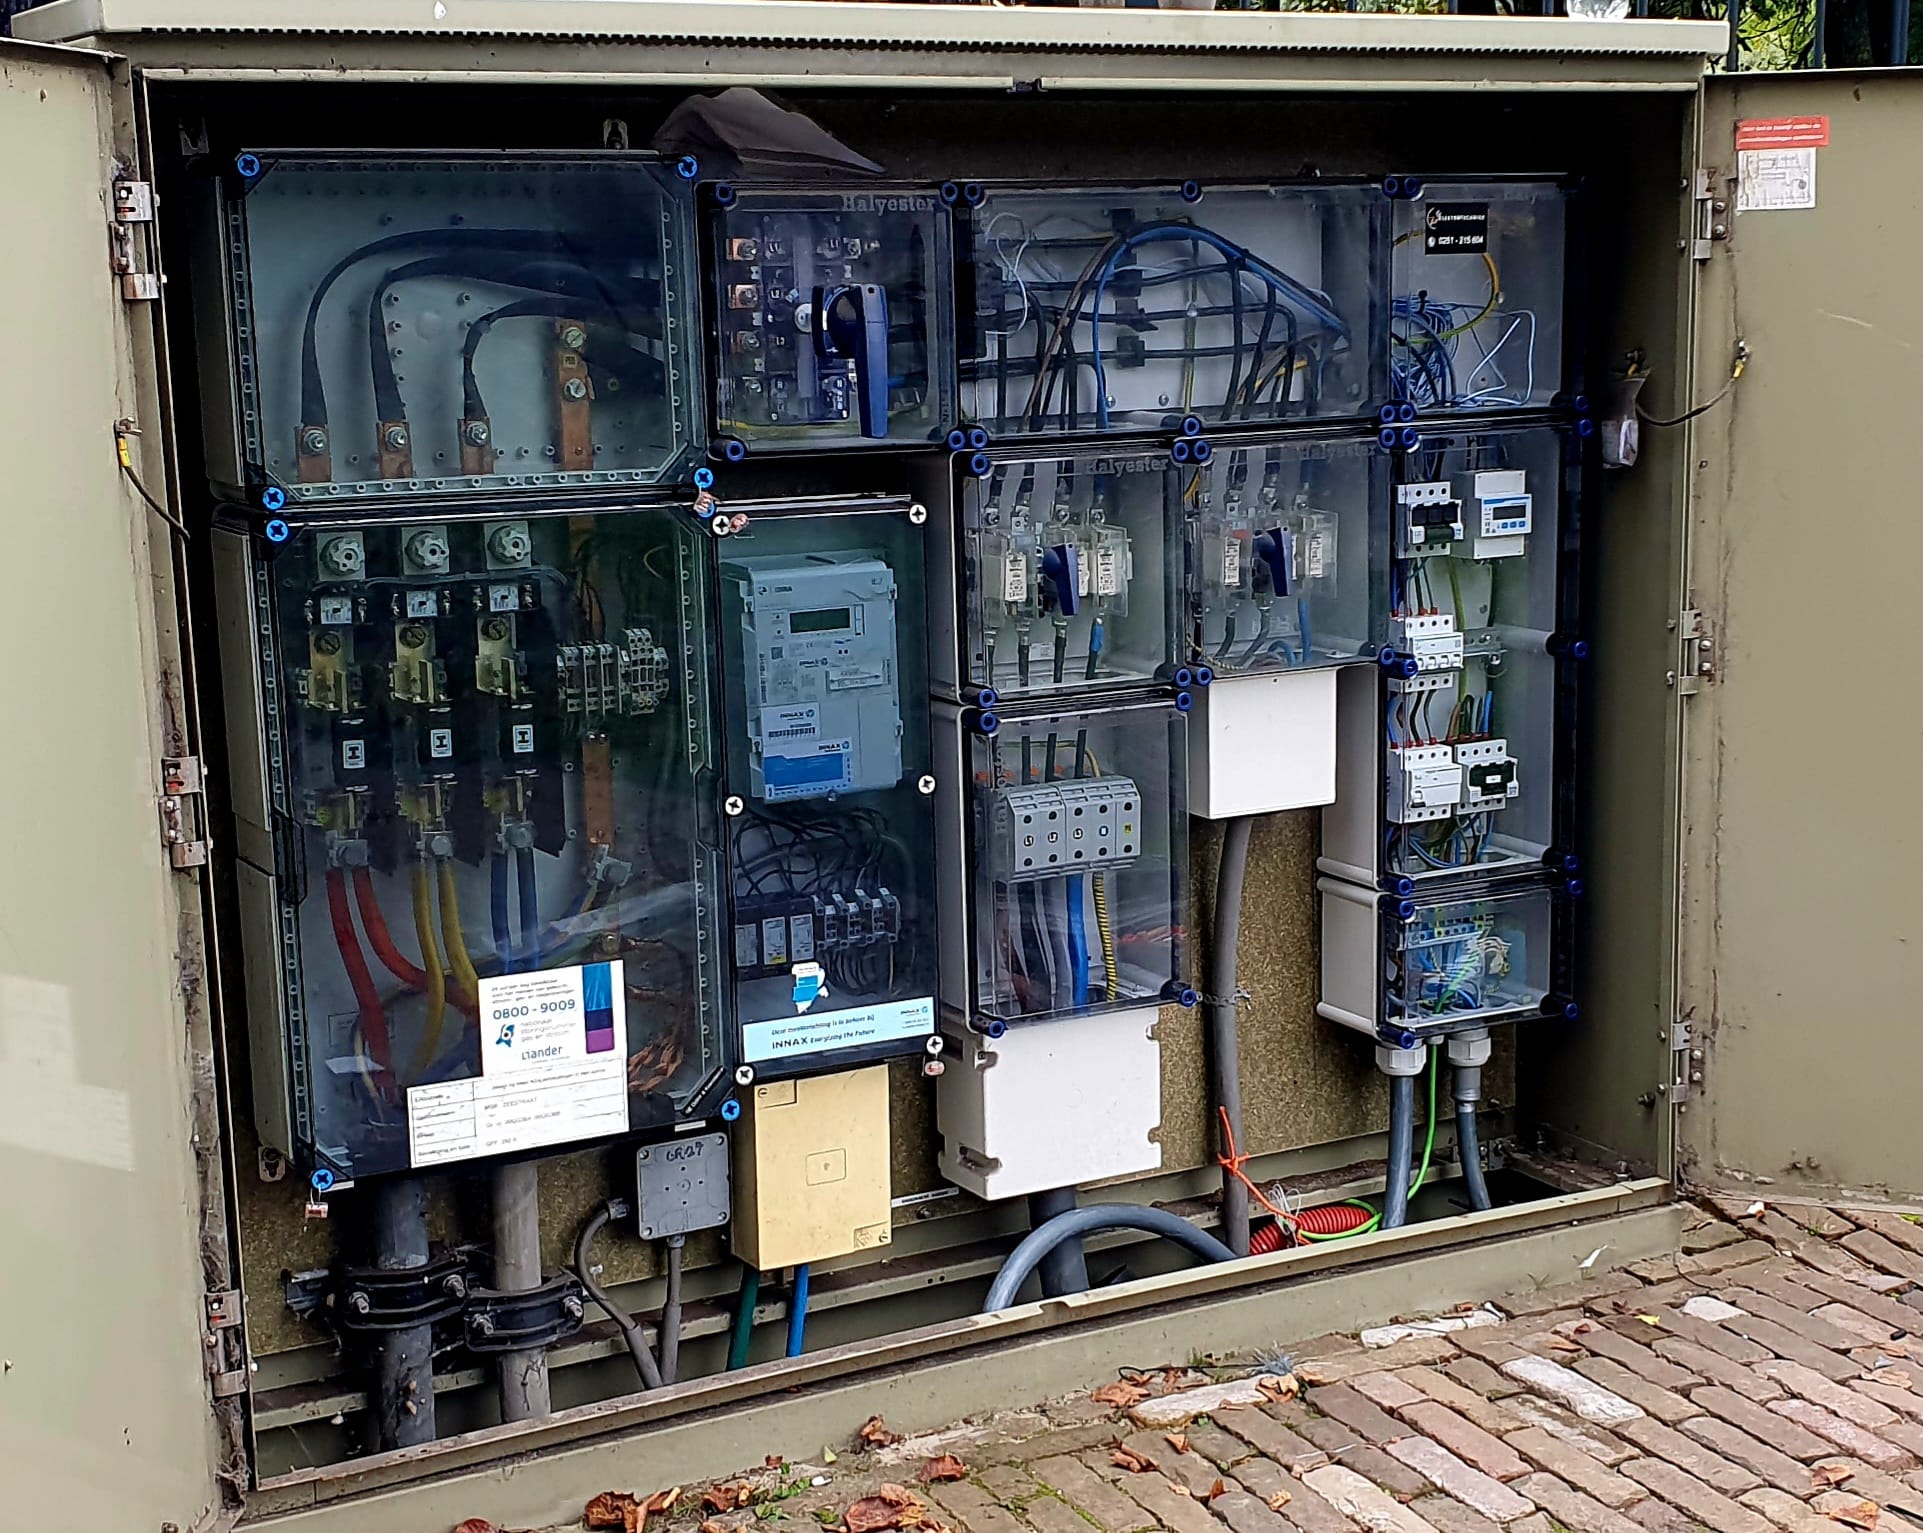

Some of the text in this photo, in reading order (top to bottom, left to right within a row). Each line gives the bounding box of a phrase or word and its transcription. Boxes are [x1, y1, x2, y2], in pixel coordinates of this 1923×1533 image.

[492, 1005, 530, 1020] 0800
[540, 998, 576, 1013] 9009
[772, 1036, 809, 1050] INNAX
